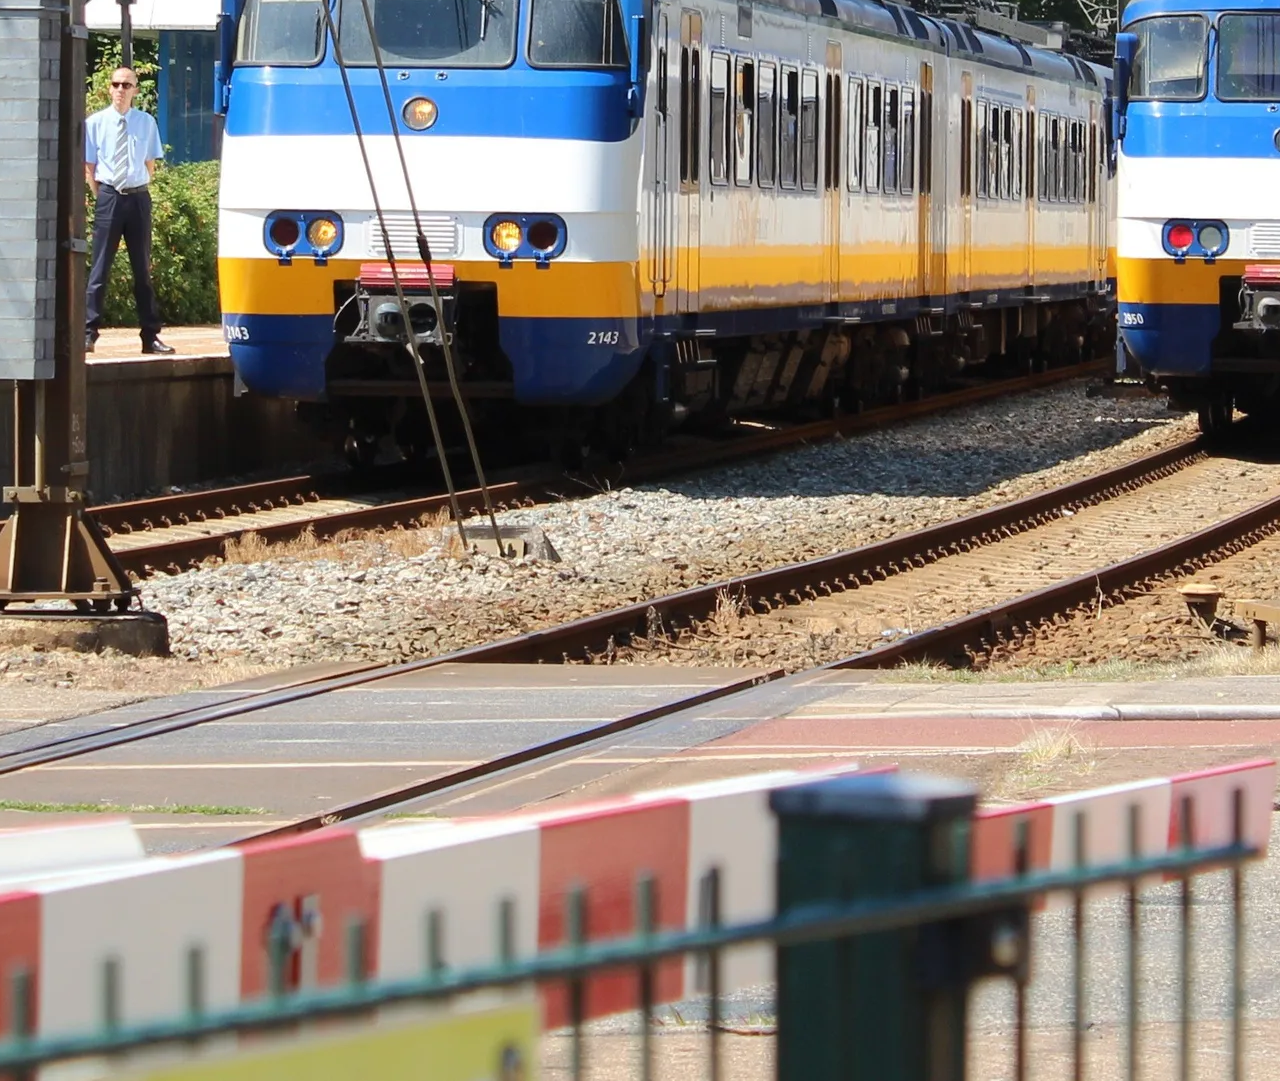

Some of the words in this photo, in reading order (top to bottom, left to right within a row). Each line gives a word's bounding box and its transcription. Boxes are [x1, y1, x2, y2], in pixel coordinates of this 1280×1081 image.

[1123, 312, 1144, 324] 2950
[225, 325, 250, 340] 2143
[587, 331, 619, 345] 2143
